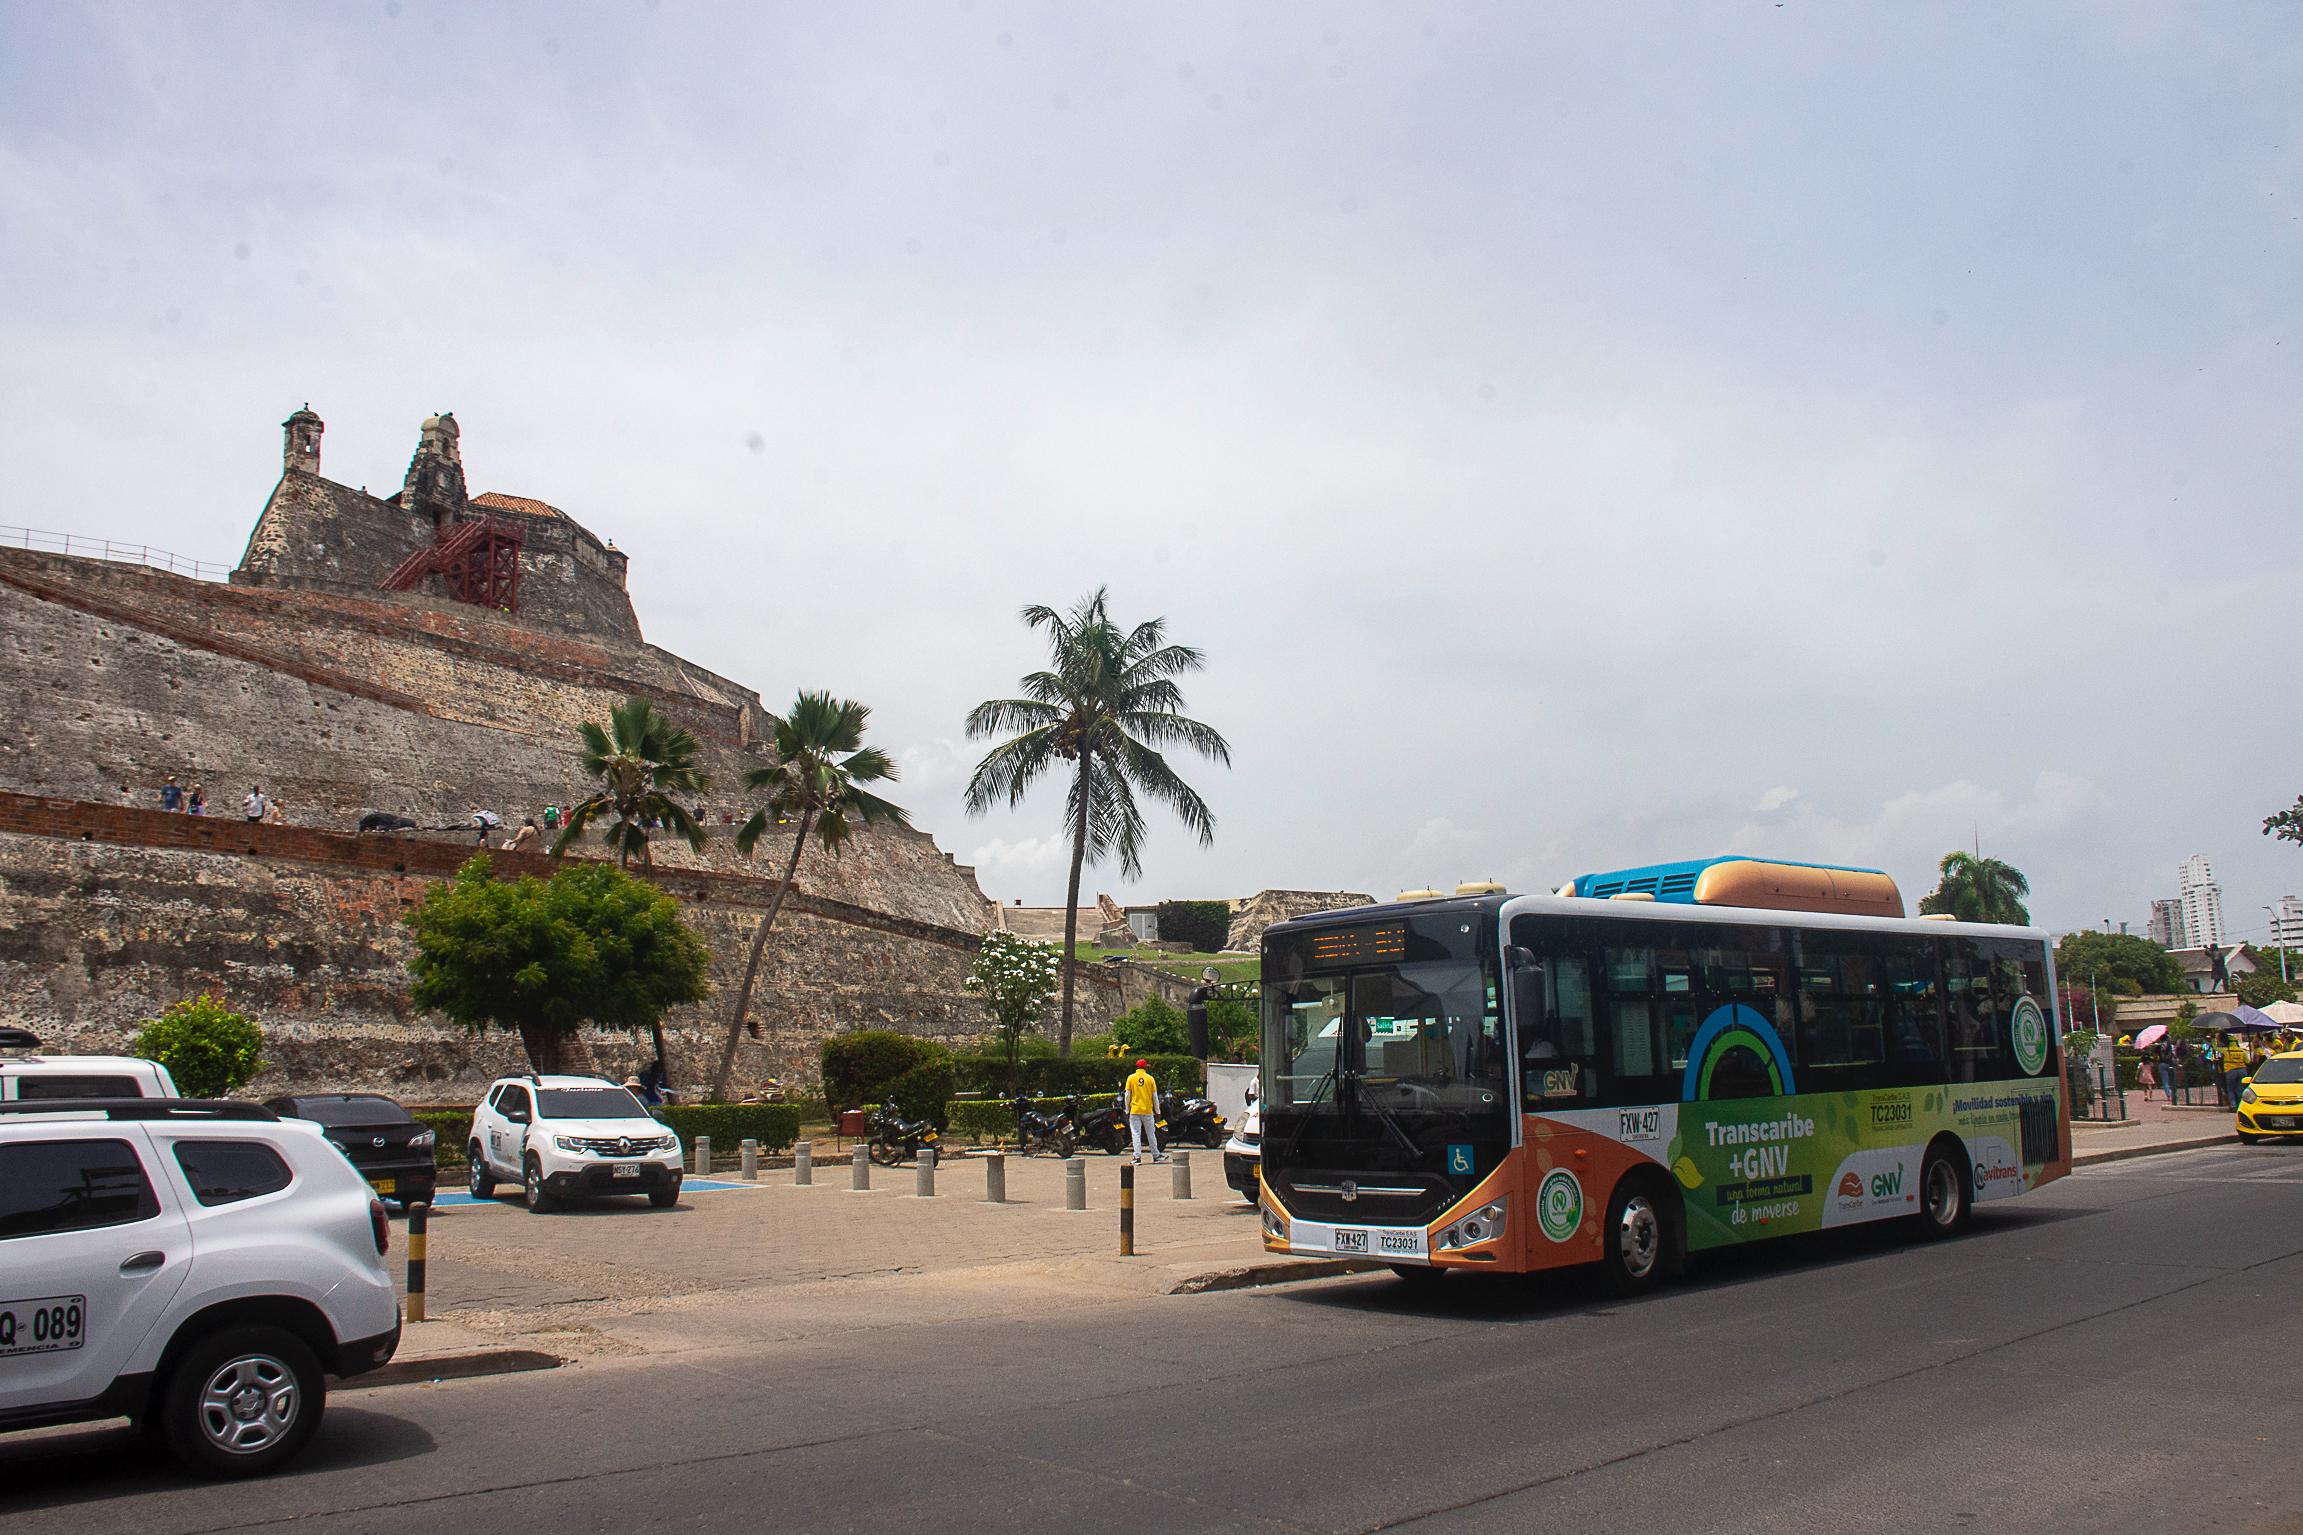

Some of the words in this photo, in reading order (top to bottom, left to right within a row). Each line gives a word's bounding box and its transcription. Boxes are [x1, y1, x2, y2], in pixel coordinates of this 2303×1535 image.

[1138, 1077, 1145, 1087] 9
[1544, 1062, 1579, 1091] GNV
[1870, 1104, 1912, 1122] TC23031
[1705, 1112, 1815, 1146] Transcaribe
[1729, 1145, 1789, 1180] +GNV
[1727, 1189, 1744, 1200] una
[1746, 1182, 1770, 1200] forma
[1773, 1176, 1804, 1195] natural
[1871, 1161, 1904, 1197] GNV
[1731, 1200, 1748, 1225] de
[1752, 1200, 1800, 1224] moverse
[1380, 1236, 1418, 1250] TC23031
[34, 1305, 82, 1341] 089
